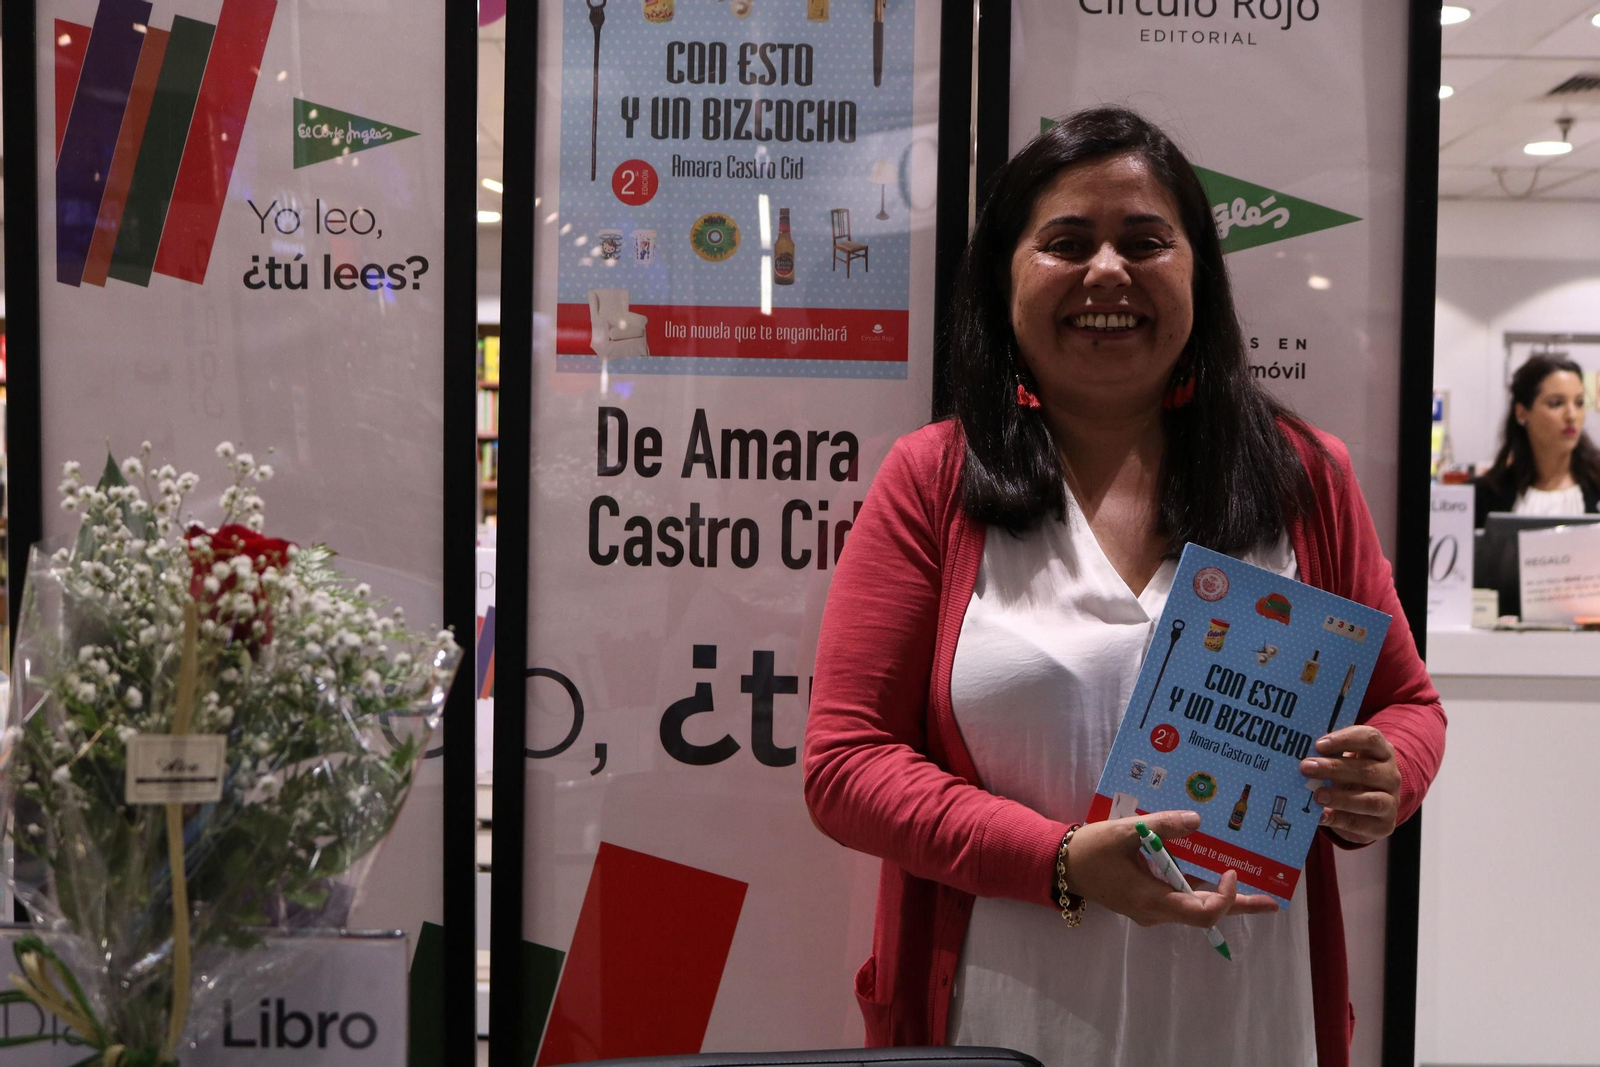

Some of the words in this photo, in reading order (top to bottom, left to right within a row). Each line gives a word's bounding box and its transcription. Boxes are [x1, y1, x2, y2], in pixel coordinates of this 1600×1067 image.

[1234, 0, 1320, 30] Rojo
[1140, 29, 1257, 46] EDITORIAL
[666, 41, 728, 85] CON
[737, 42, 813, 87] ESTO
[298, 123, 312, 138] El
[312, 124, 344, 139] Corte
[620, 96, 640, 139] Y
[651, 96, 690, 140] UN
[702, 98, 857, 144] BIZCOCHO
[672, 154, 722, 178] Amara
[727, 155, 776, 180] Castro
[781, 156, 804, 180] Cid
[247, 199, 300, 235] Yo
[316, 198, 382, 239] leo,
[243, 250, 309, 290] ¿tú
[324, 254, 429, 290] lees?
[664, 320, 686, 338] Una
[690, 322, 730, 340] novela
[734, 325, 756, 343] que
[760, 324, 772, 340] te
[776, 324, 847, 344] enganchará
[1279, 338, 1306, 350] EN
[597, 406, 663, 479] De
[681, 408, 859, 482] Amara
[588, 495, 759, 569] Castro
[1204, 664, 1247, 700] CON
[1247, 679, 1298, 719] ESTO
[1168, 686, 1185, 712] Y
[1184, 692, 1214, 725] UN
[1214, 704, 1313, 762] BIZCOCHO
[1188, 730, 1220, 754] Amara
[1220, 742, 1252, 766] Castro
[1253, 753, 1270, 772] Cid
[1192, 843, 1208, 856] que
[1208, 848, 1216, 860] te
[1217, 853, 1263, 877] enganchará
[222, 998, 378, 1050] Libro
